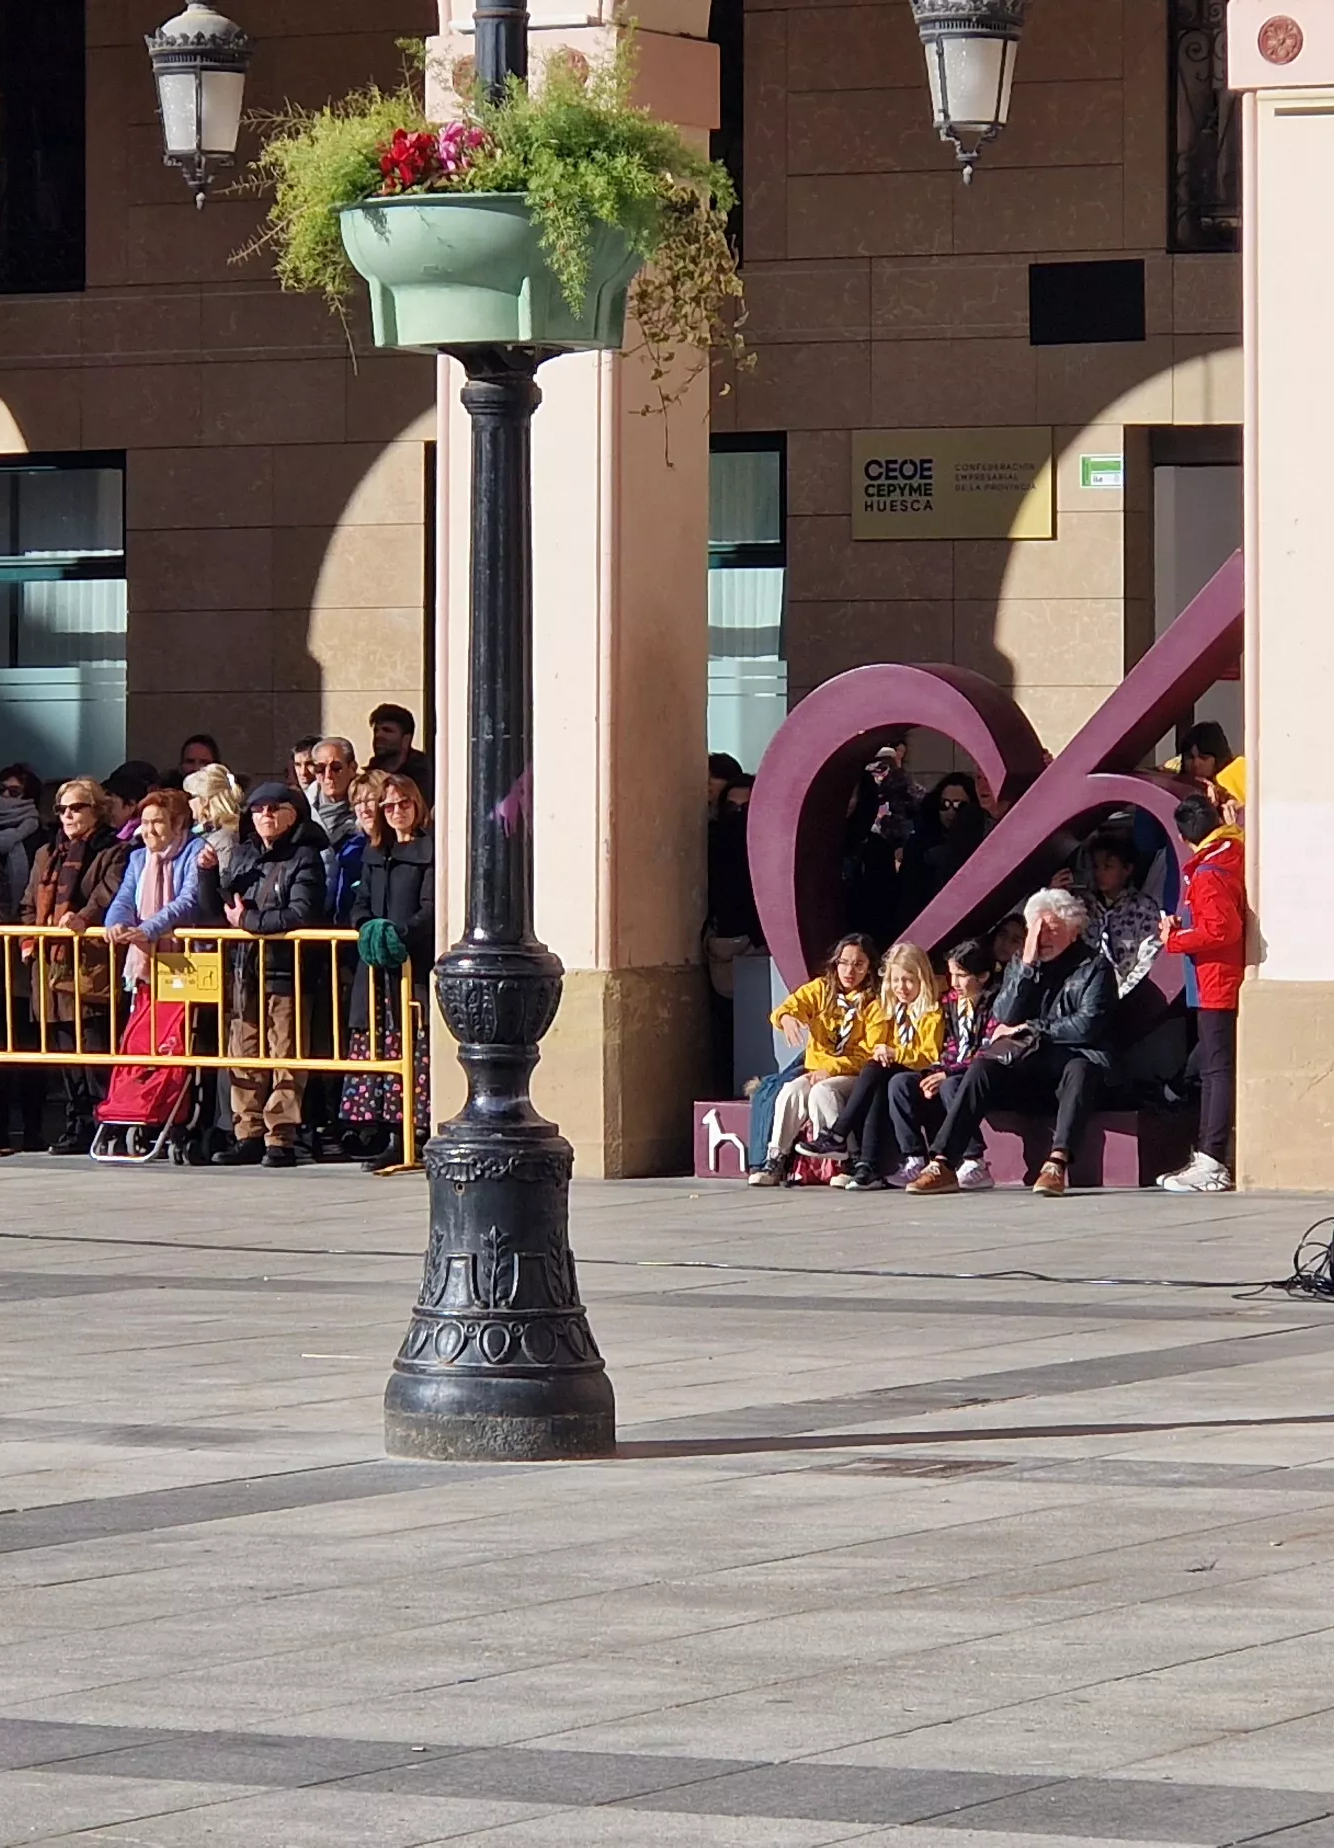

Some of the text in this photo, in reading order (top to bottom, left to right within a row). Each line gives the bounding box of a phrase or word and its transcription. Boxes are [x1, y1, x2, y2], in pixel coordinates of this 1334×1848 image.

[864, 458, 933, 481] CEOE
[864, 483, 933, 497] CEPYME
[864, 499, 934, 512] HUESCA
